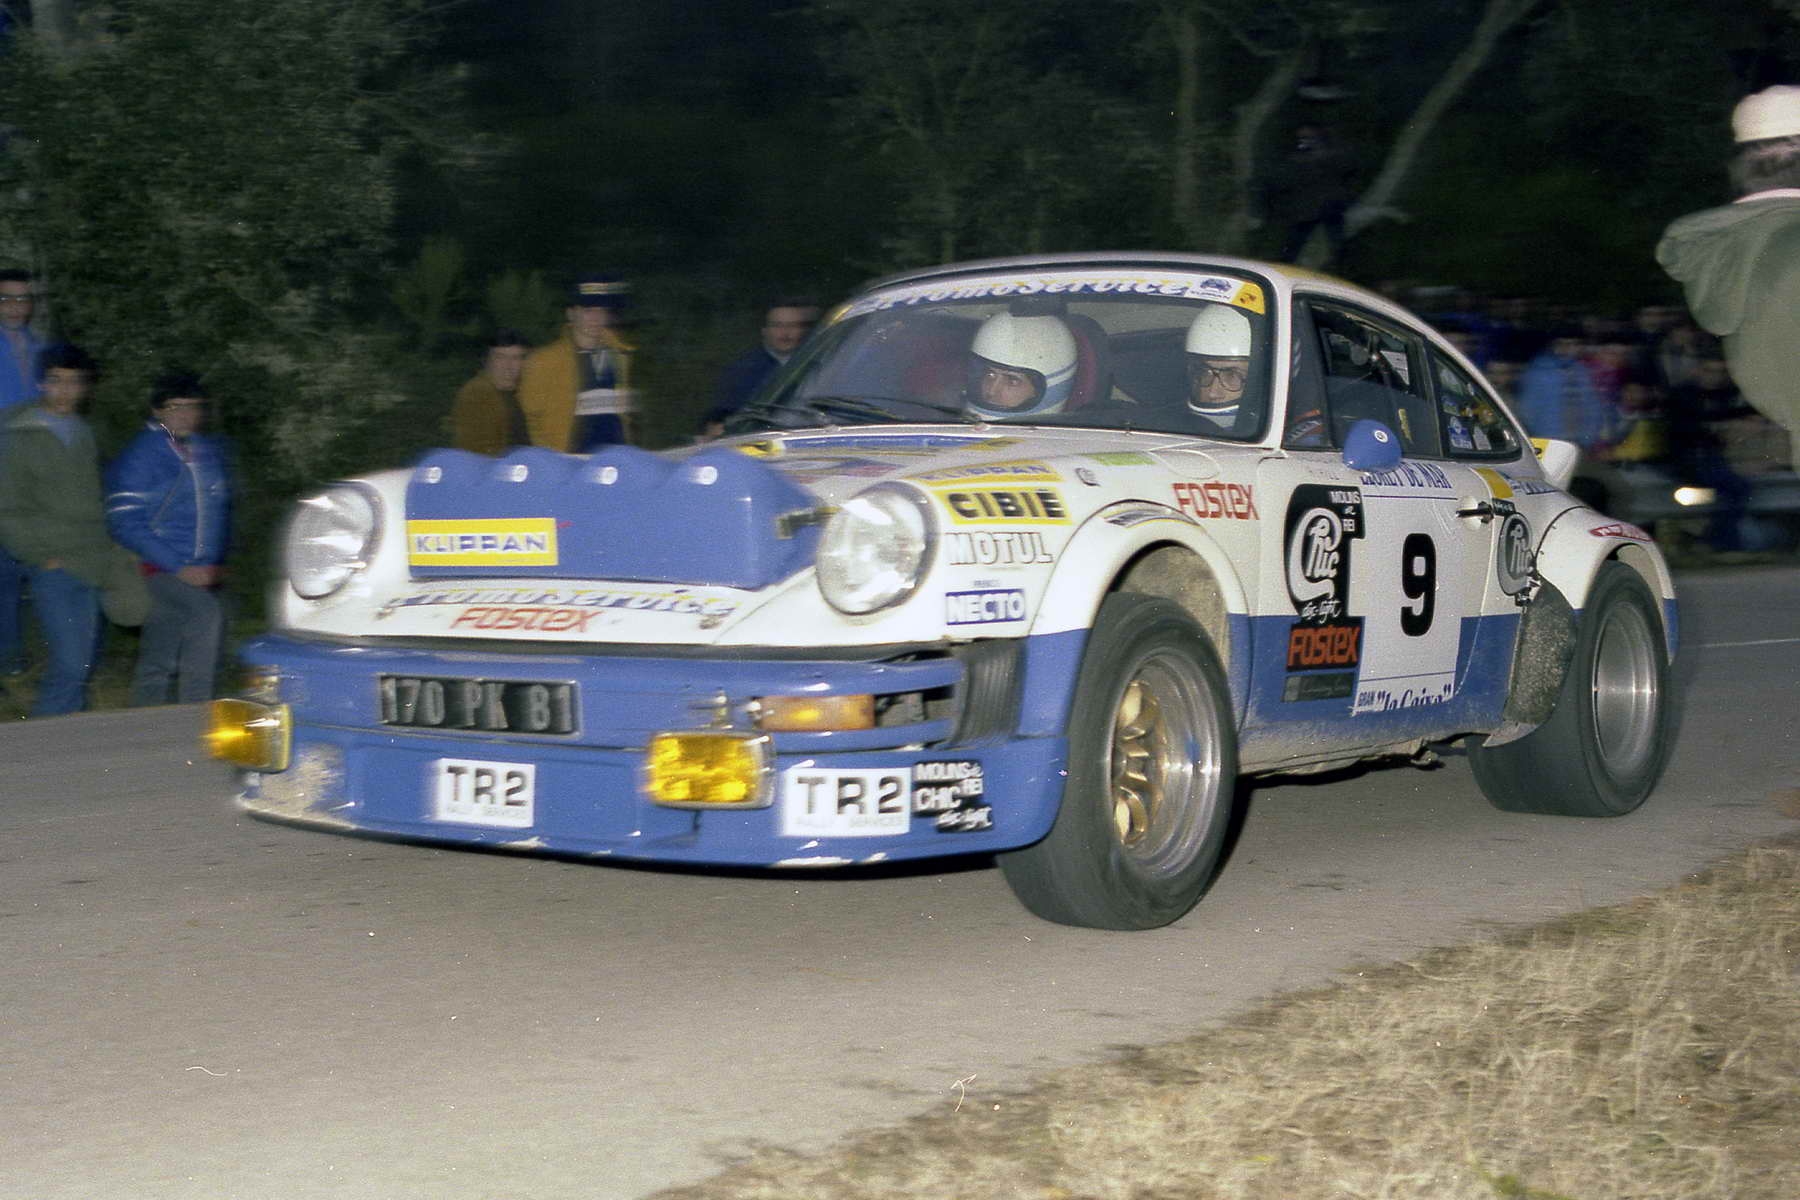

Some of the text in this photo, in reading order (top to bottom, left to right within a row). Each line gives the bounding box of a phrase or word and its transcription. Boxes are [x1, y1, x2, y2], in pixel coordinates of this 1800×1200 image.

[415, 534, 546, 553] KLIPPAN
[944, 531, 1055, 565] MOTUL
[1401, 533, 1437, 637] 9
[945, 590, 1025, 624] NECTO
[381, 677, 572, 733] 170 PK 81
[446, 765, 528, 806] TR2
[915, 763, 973, 779] MOLINS
[796, 775, 905, 815] TR2
[912, 786, 962, 812] CHIC
